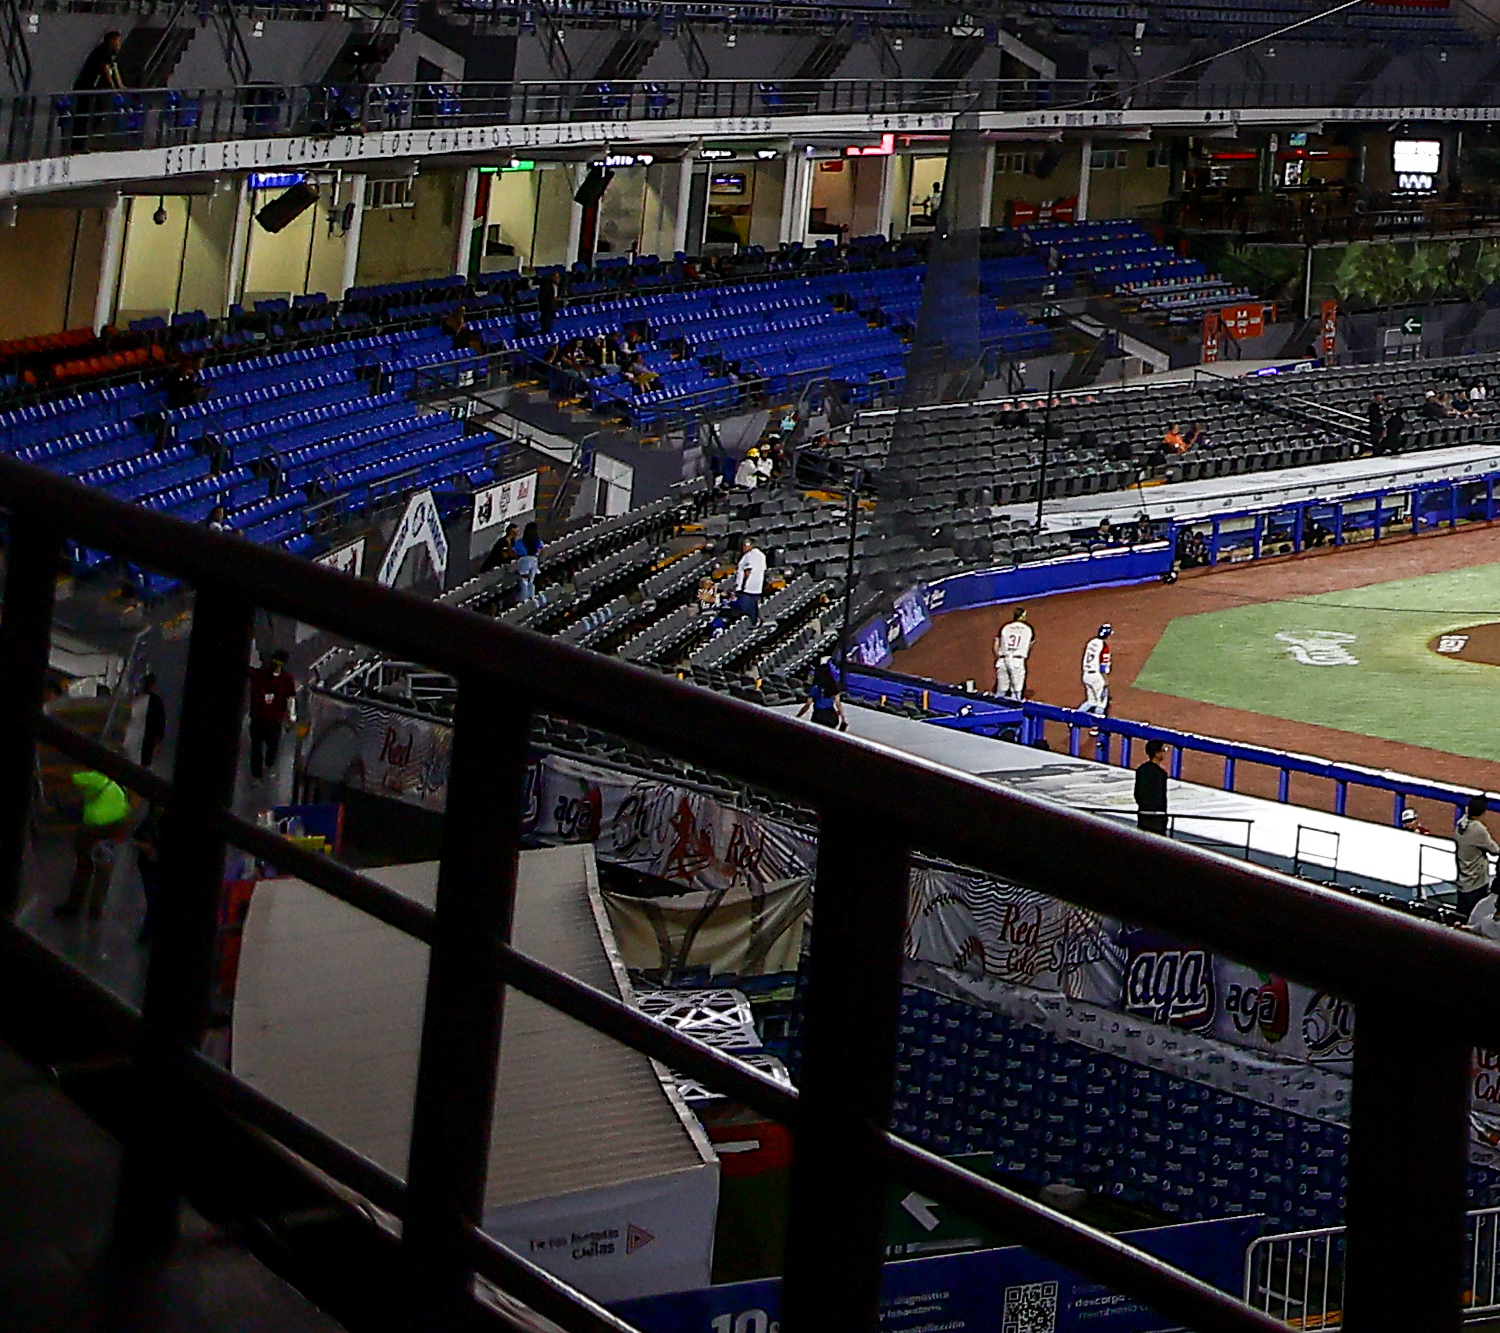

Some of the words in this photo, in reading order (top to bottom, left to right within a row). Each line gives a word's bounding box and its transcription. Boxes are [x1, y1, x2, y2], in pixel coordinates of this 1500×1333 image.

[345, 135, 365, 157] DE
[380, 132, 414, 153] LOS
[427, 127, 513, 151] CHARROS
[524, 127, 540, 145] DE
[556, 122, 631, 144] JALISCO
[998, 902, 1041, 948] Red
[1128, 950, 1210, 1025] aga
[1225, 984, 1277, 1034] aga
